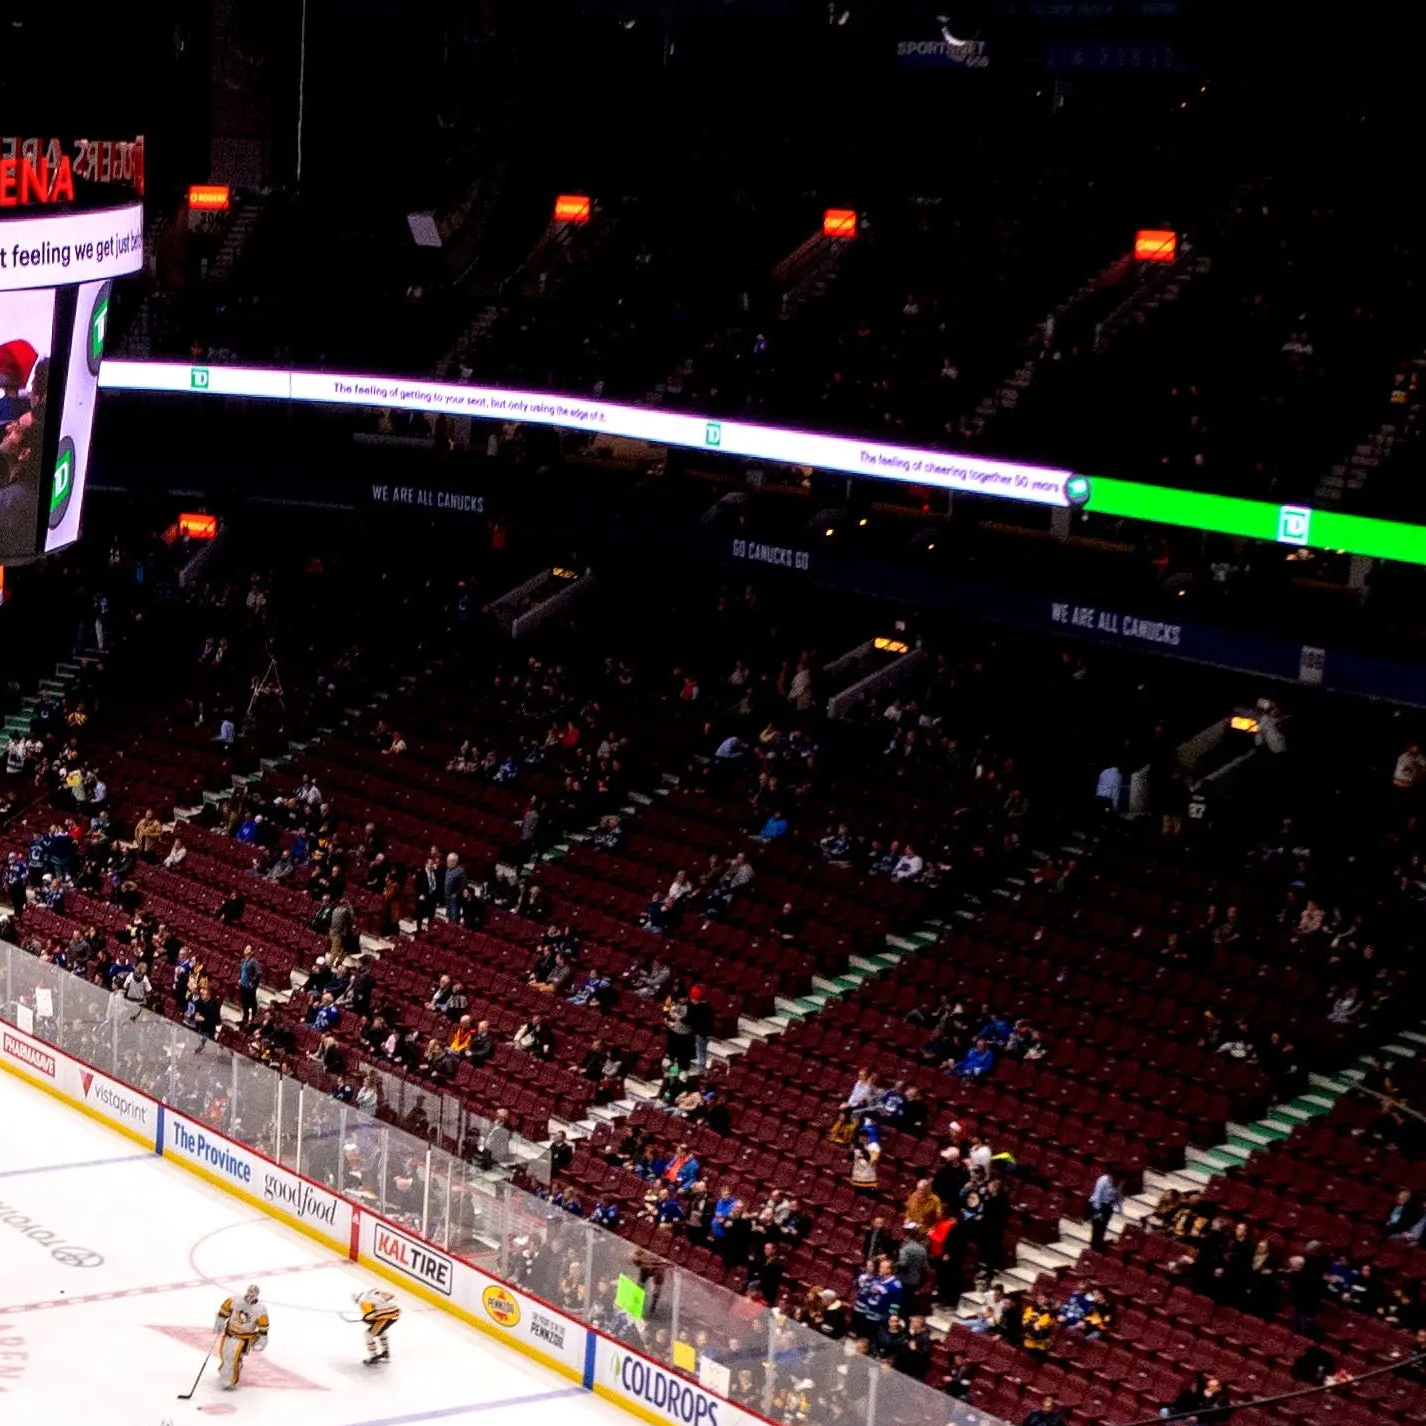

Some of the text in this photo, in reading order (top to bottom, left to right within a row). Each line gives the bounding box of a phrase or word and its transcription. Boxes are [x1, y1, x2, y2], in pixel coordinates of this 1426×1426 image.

[12, 240, 71, 268] feeling
[75, 243, 93, 261] we
[96, 238, 114, 262] get
[115, 232, 130, 260] just
[334, 382, 352, 394] The
[354, 383, 388, 399] feeling
[372, 484, 484, 513] WE ARE ALL CANUCKS
[1051, 602, 1069, 622] WE
[1098, 609, 1118, 634] ALL
[94, 1083, 147, 1124] vistaprint
[173, 1121, 251, 1184] The Province
[264, 1172, 338, 1227] goodfood
[378, 1231, 449, 1286] KAL TIRE
